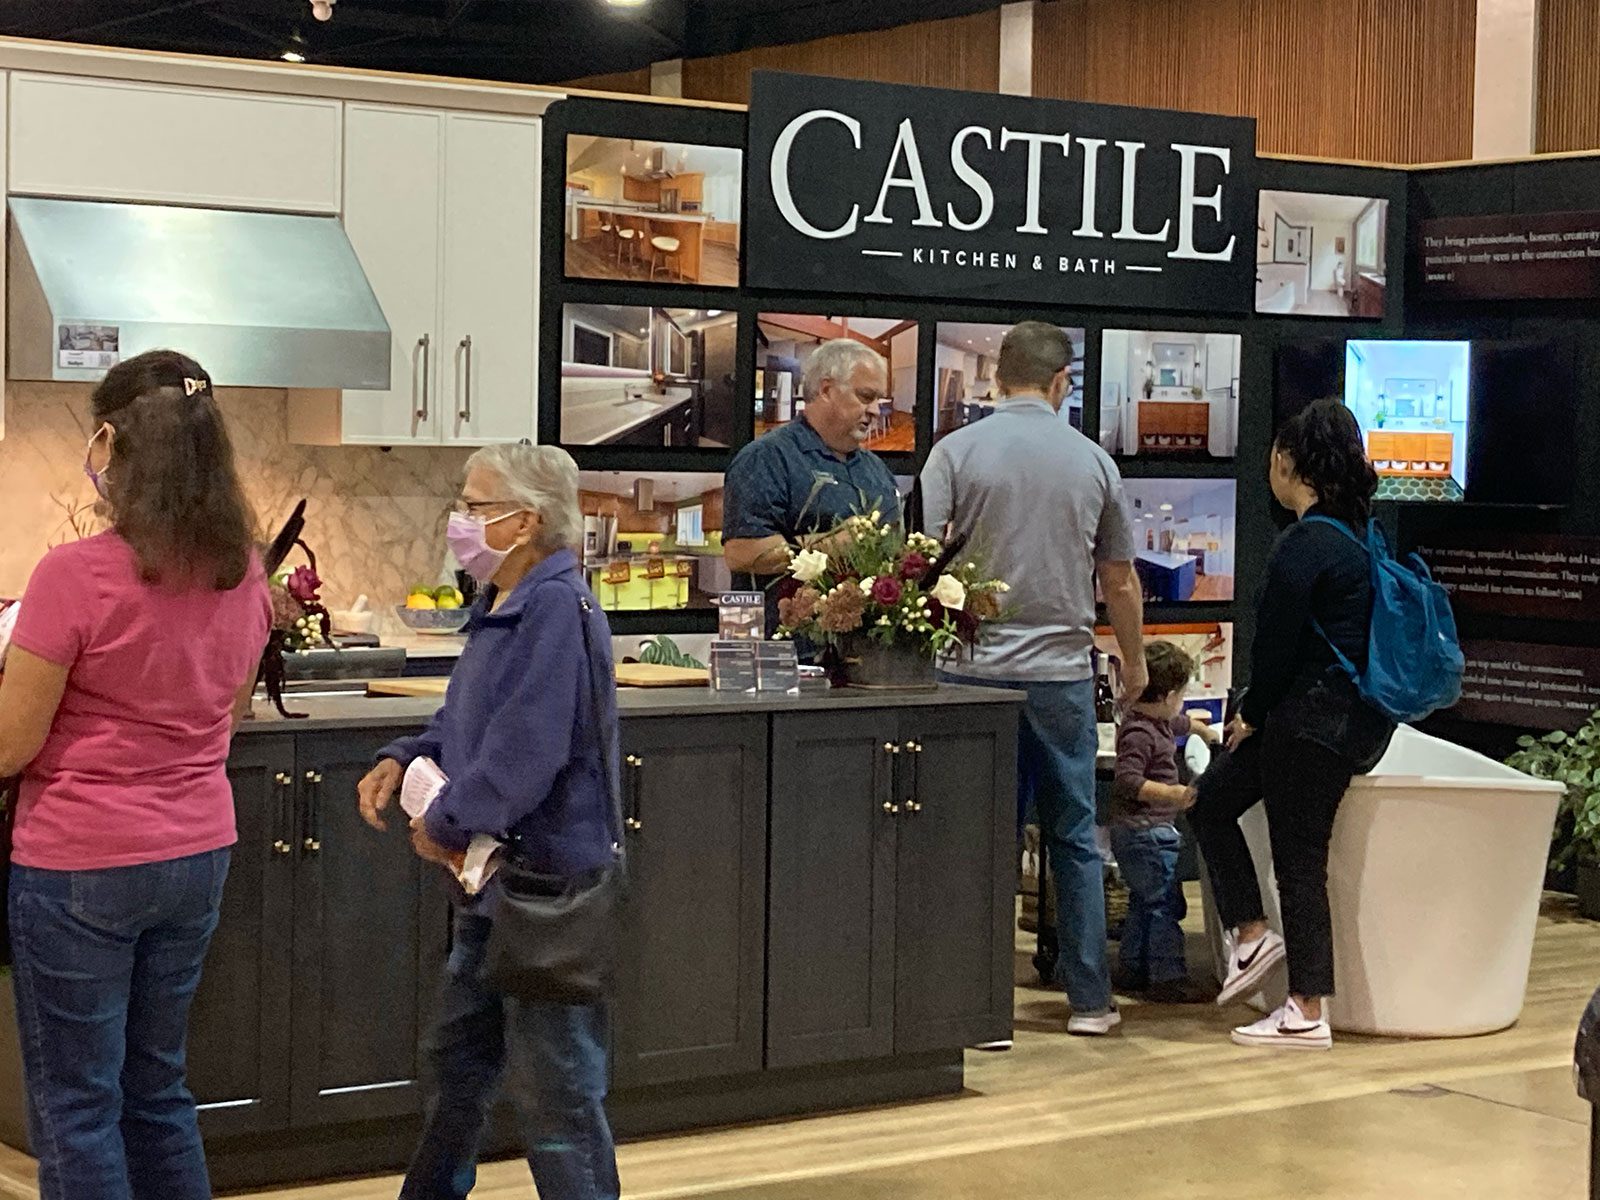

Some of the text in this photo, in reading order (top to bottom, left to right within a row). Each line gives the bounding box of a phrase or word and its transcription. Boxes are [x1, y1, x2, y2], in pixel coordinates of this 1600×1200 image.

[770, 109, 1236, 262] CASTILE
[1522, 250, 1533, 259] the
[913, 248, 1116, 275] KITCHEN & BATH
[1561, 571, 1578, 583] They
[721, 595, 761, 604] CASTILE
